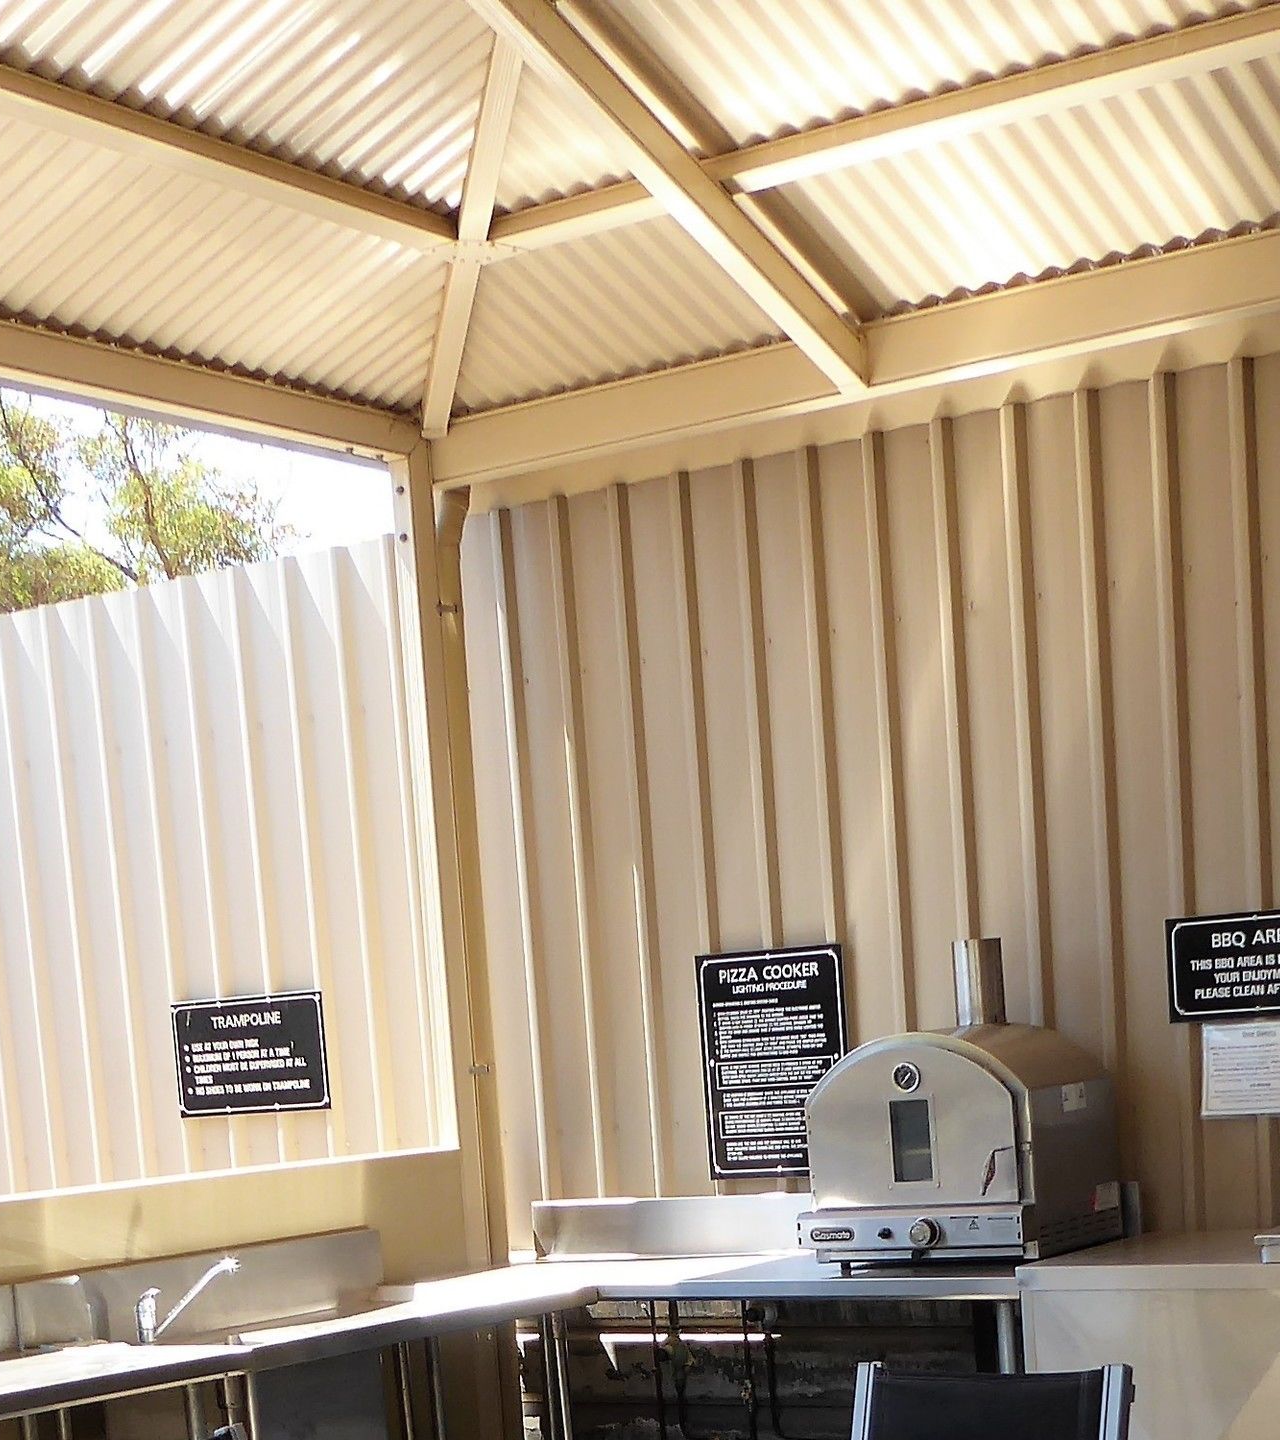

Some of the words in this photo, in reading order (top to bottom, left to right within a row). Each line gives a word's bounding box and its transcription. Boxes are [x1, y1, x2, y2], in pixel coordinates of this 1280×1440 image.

[1211, 931, 1246, 948] BBQ
[1190, 958, 1213, 971] THIS
[1214, 957, 1235, 969] BBQ
[1236, 955, 1263, 968] AREA
[1265, 955, 1276, 966] IS
[718, 967, 759, 984] PIZZA
[762, 962, 820, 980] COOKER
[1214, 972, 1240, 984] YOUR
[732, 983, 765, 994] LIGHTING
[765, 979, 808, 992] PROCEDURE
[1194, 987, 1231, 1000] PLEASE
[1232, 985, 1265, 997] CLEAN
[210, 1011, 282, 1030] TRAMPOLINE
